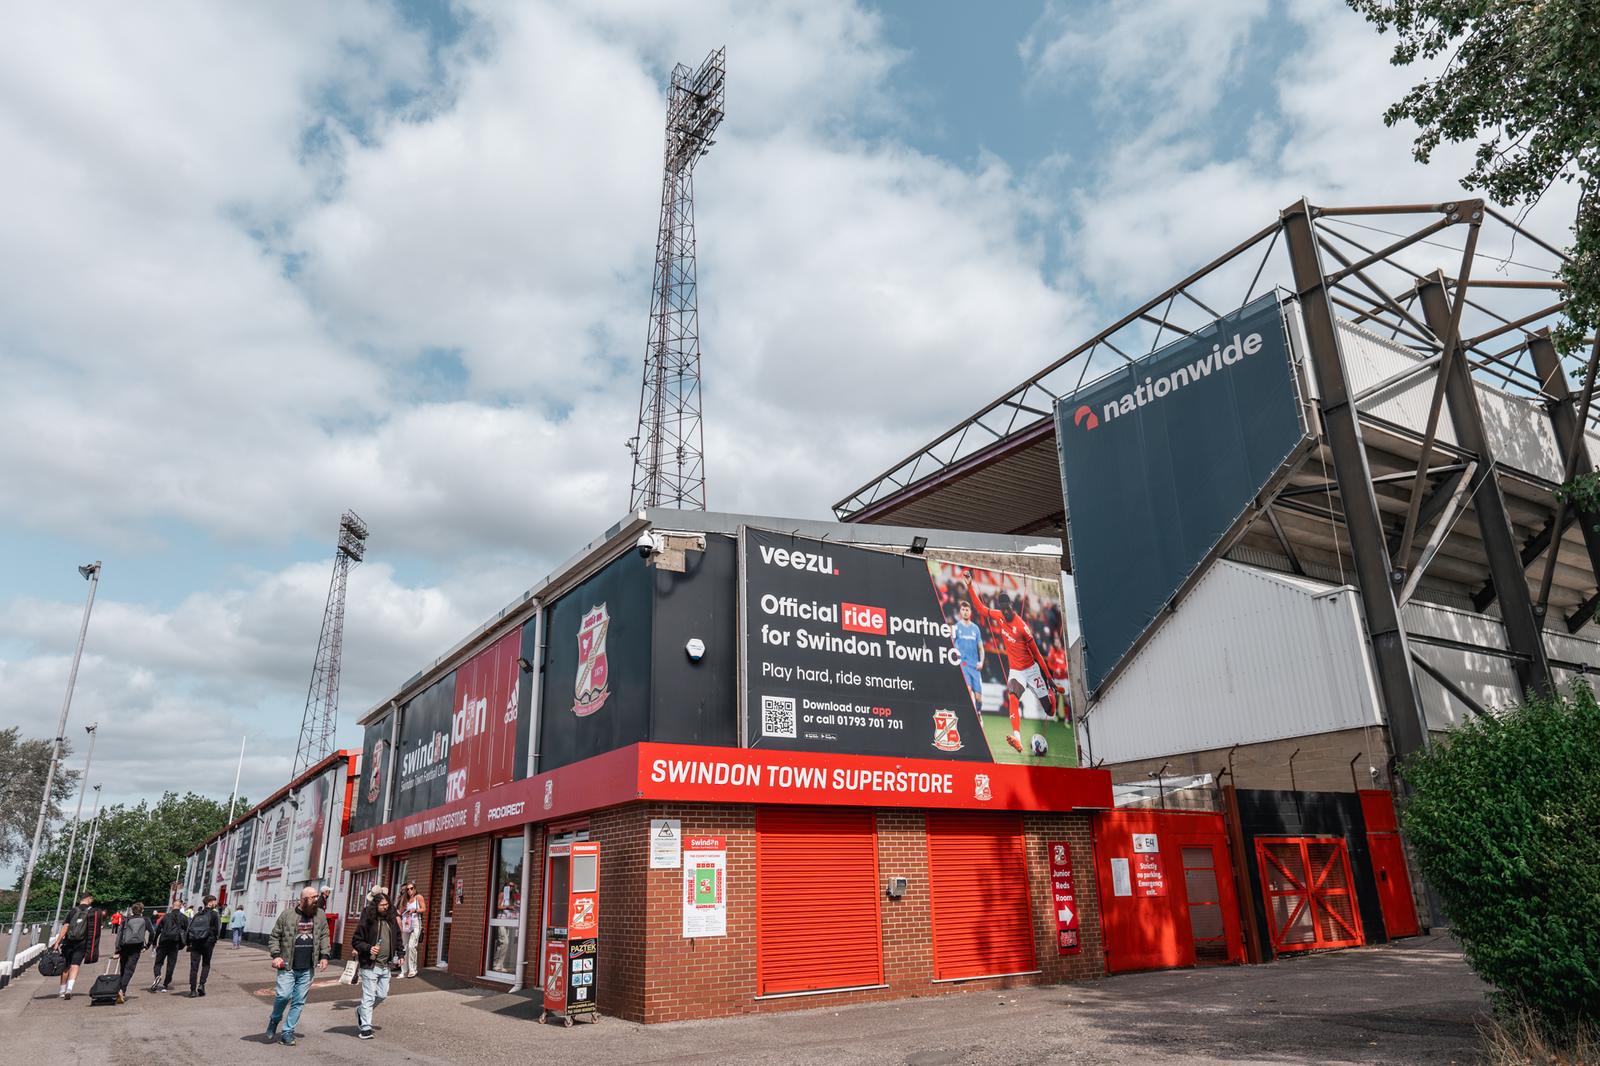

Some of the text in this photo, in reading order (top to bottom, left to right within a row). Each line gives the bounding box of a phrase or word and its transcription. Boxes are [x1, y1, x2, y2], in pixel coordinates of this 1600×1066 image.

[1103, 332, 1263, 422] nationwide
[761, 593, 958, 639] Official ride partner
[761, 624, 790, 646] for
[797, 628, 881, 657] Swindon
[886, 640, 933, 663] Town
[762, 662, 915, 691] Play hard, ride smarter.
[803, 699, 891, 717] Download our app
[803, 715, 903, 730] or call 01793 701 701
[402, 730, 449, 777] swindn
[651, 759, 953, 794] SWINDON TOWN SUPERSTORE
[435, 809, 467, 832] SUPERSTORE
[1145, 838, 1155, 848] E4
[1053, 869, 1070, 877] Junior
[1140, 862, 1157, 870] Strictly
[1056, 881, 1070, 889] Reds
[1138, 880, 1163, 888] Emergency
[1055, 894, 1073, 902] Room
[570, 943, 596, 952] PAZTEK
